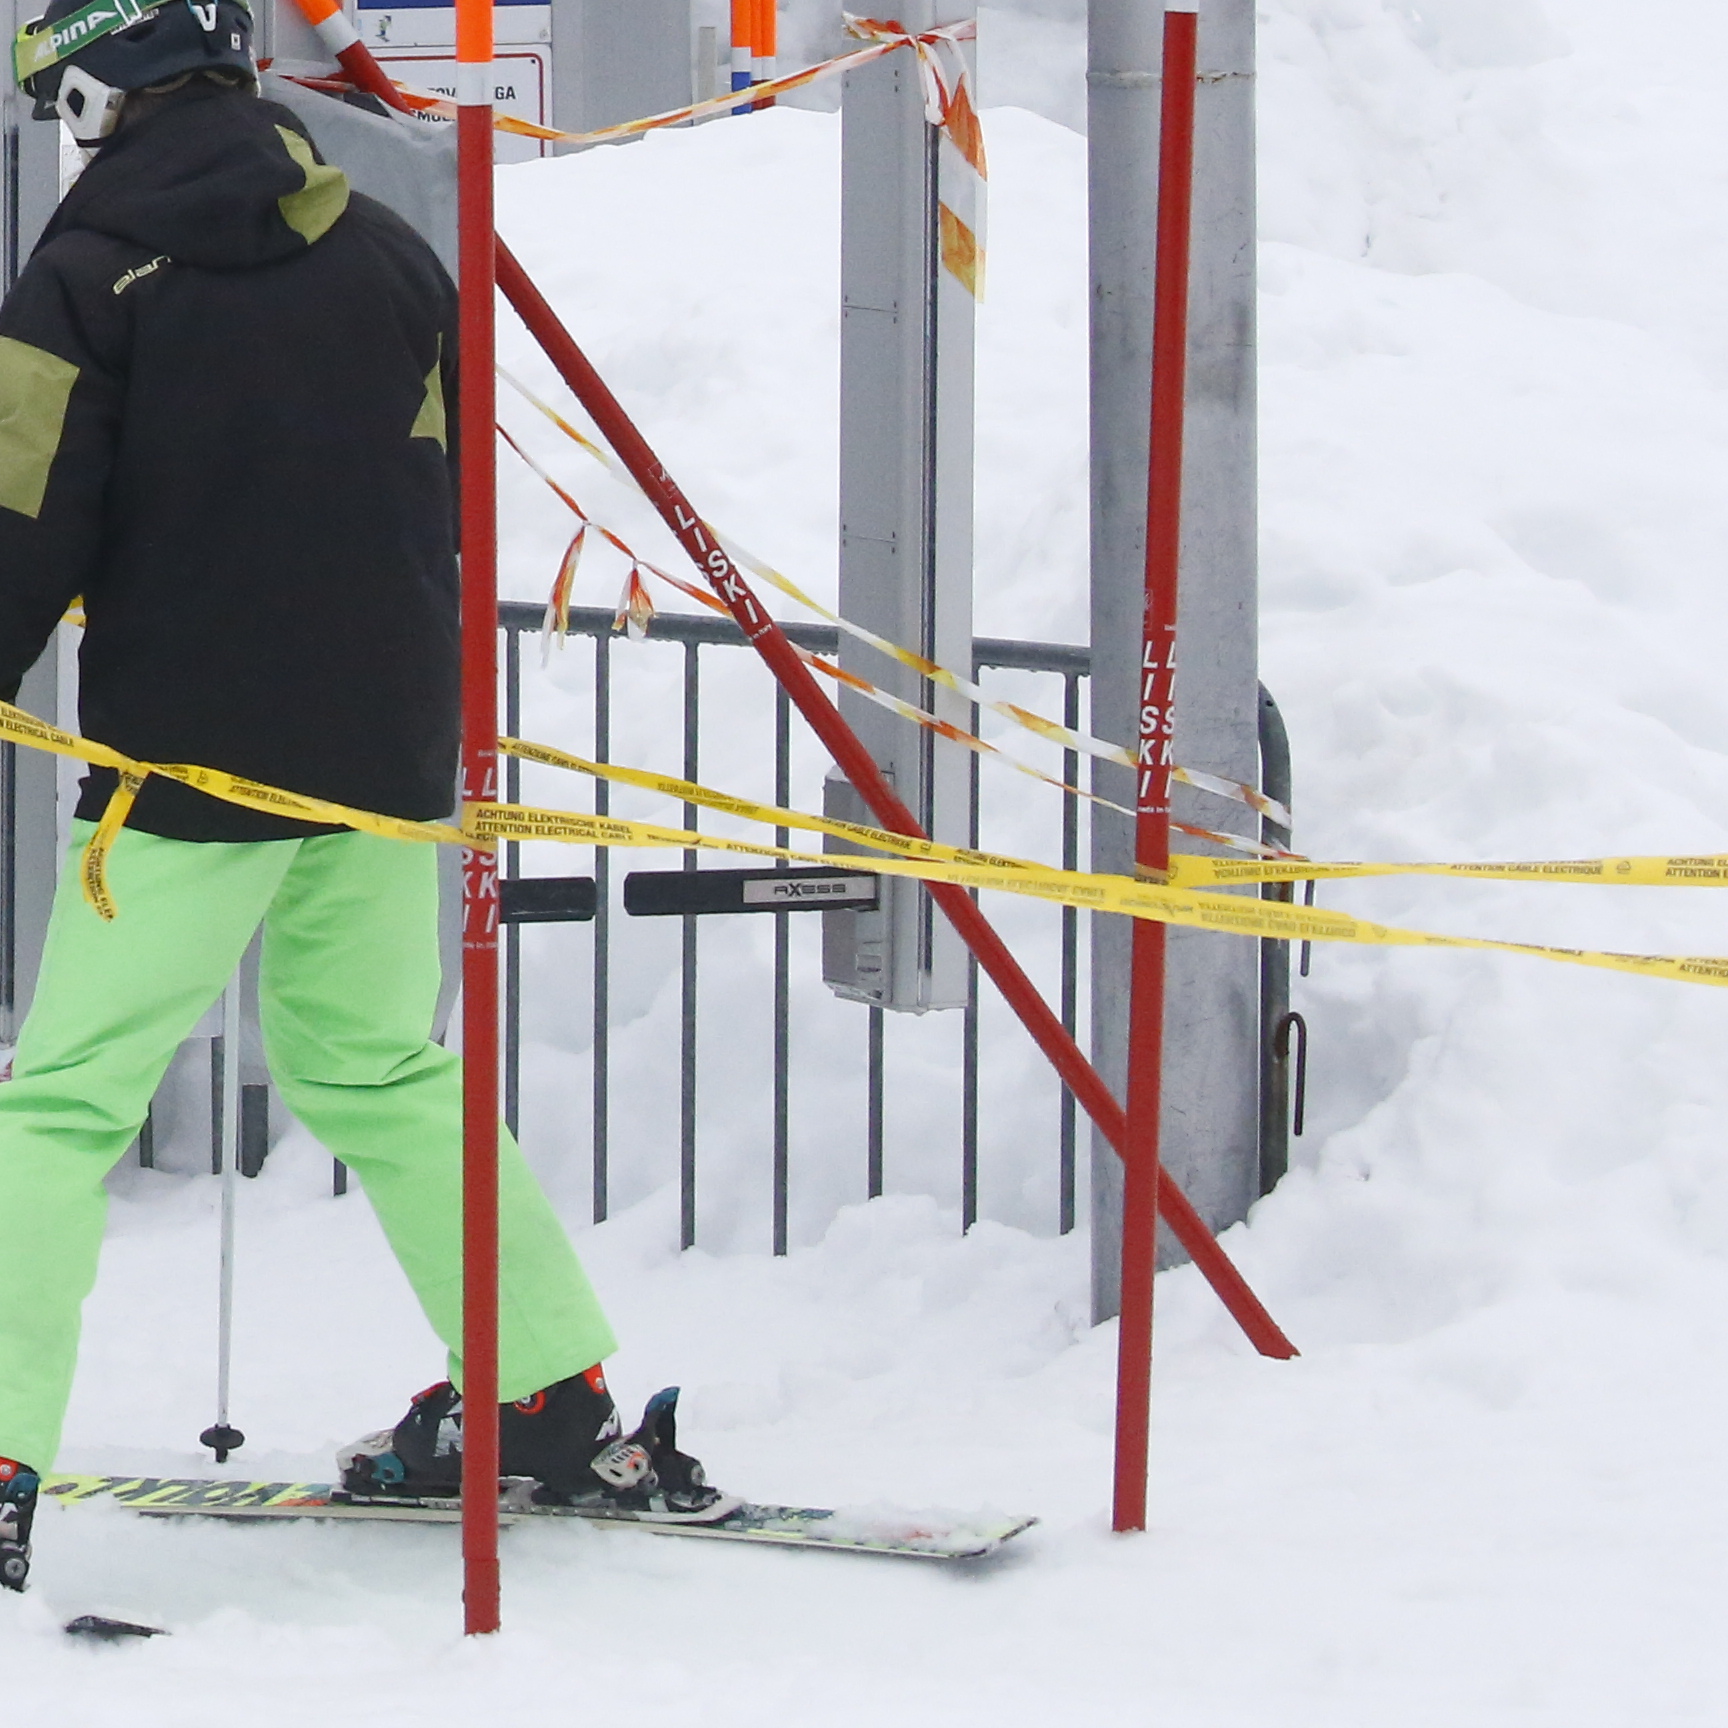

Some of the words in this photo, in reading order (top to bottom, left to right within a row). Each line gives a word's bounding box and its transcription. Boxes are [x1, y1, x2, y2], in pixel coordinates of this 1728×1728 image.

[674, 505, 758, 624] LISKI
[1139, 640, 1159, 798] LISKI
[476, 809, 524, 821] ACHTUNG
[475, 822, 532, 834] ATTENTION
[535, 825, 598, 838] ELECTRICAL
[1665, 867, 1719, 879] ATTENTION
[774, 882, 846, 897] AXESS
